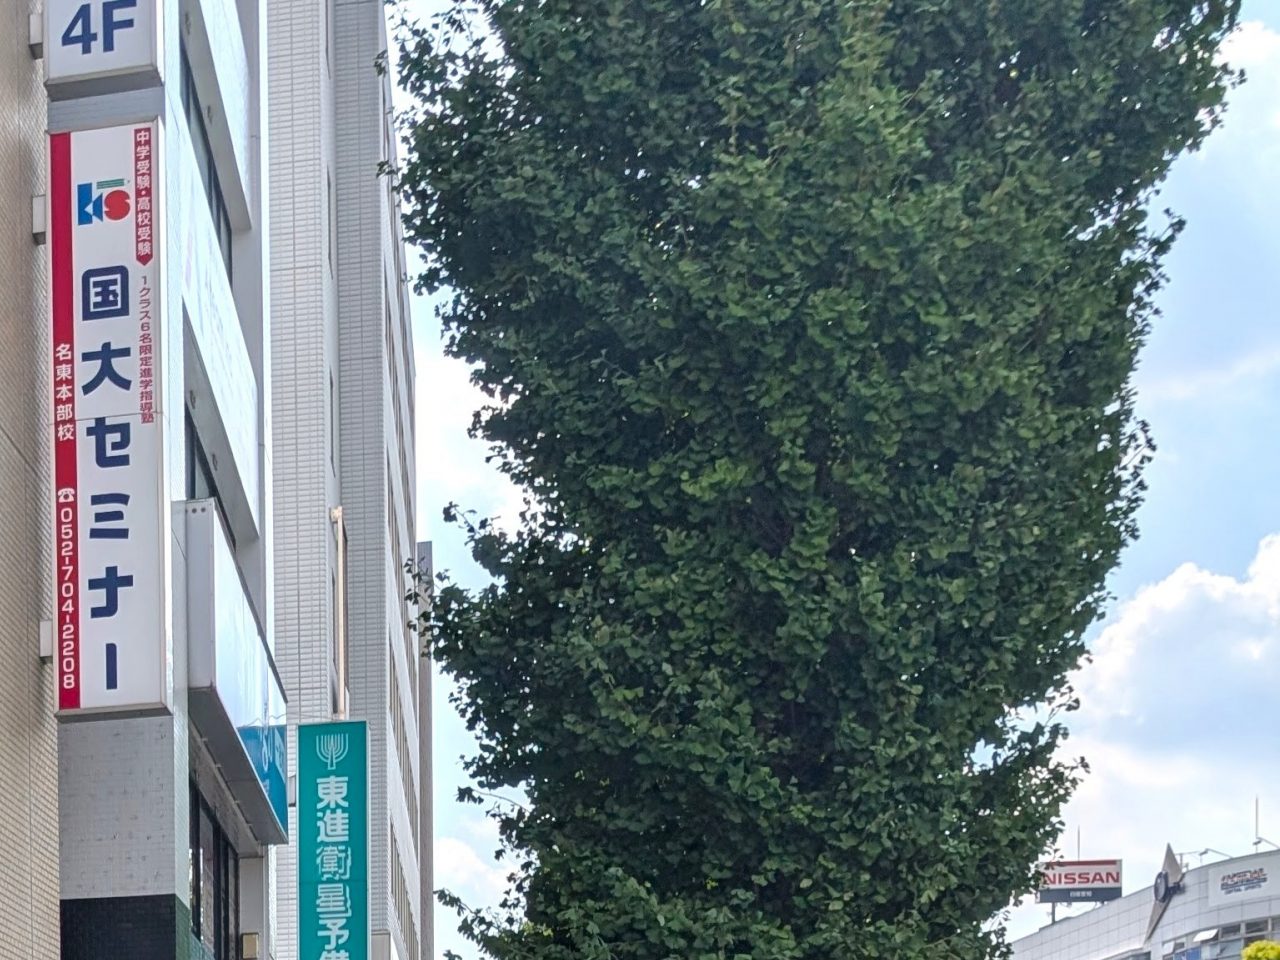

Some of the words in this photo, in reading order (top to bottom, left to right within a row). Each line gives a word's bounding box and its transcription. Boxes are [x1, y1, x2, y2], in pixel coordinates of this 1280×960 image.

[61, 0, 137, 56] 4F
[136, 130, 152, 257] 中学受験・高校受験
[55, 343, 75, 442] 名東本部校
[81, 265, 134, 690] 国大セミナー
[59, 507, 76, 690] 052-704-2208
[1041, 871, 1120, 885] NISSAN
